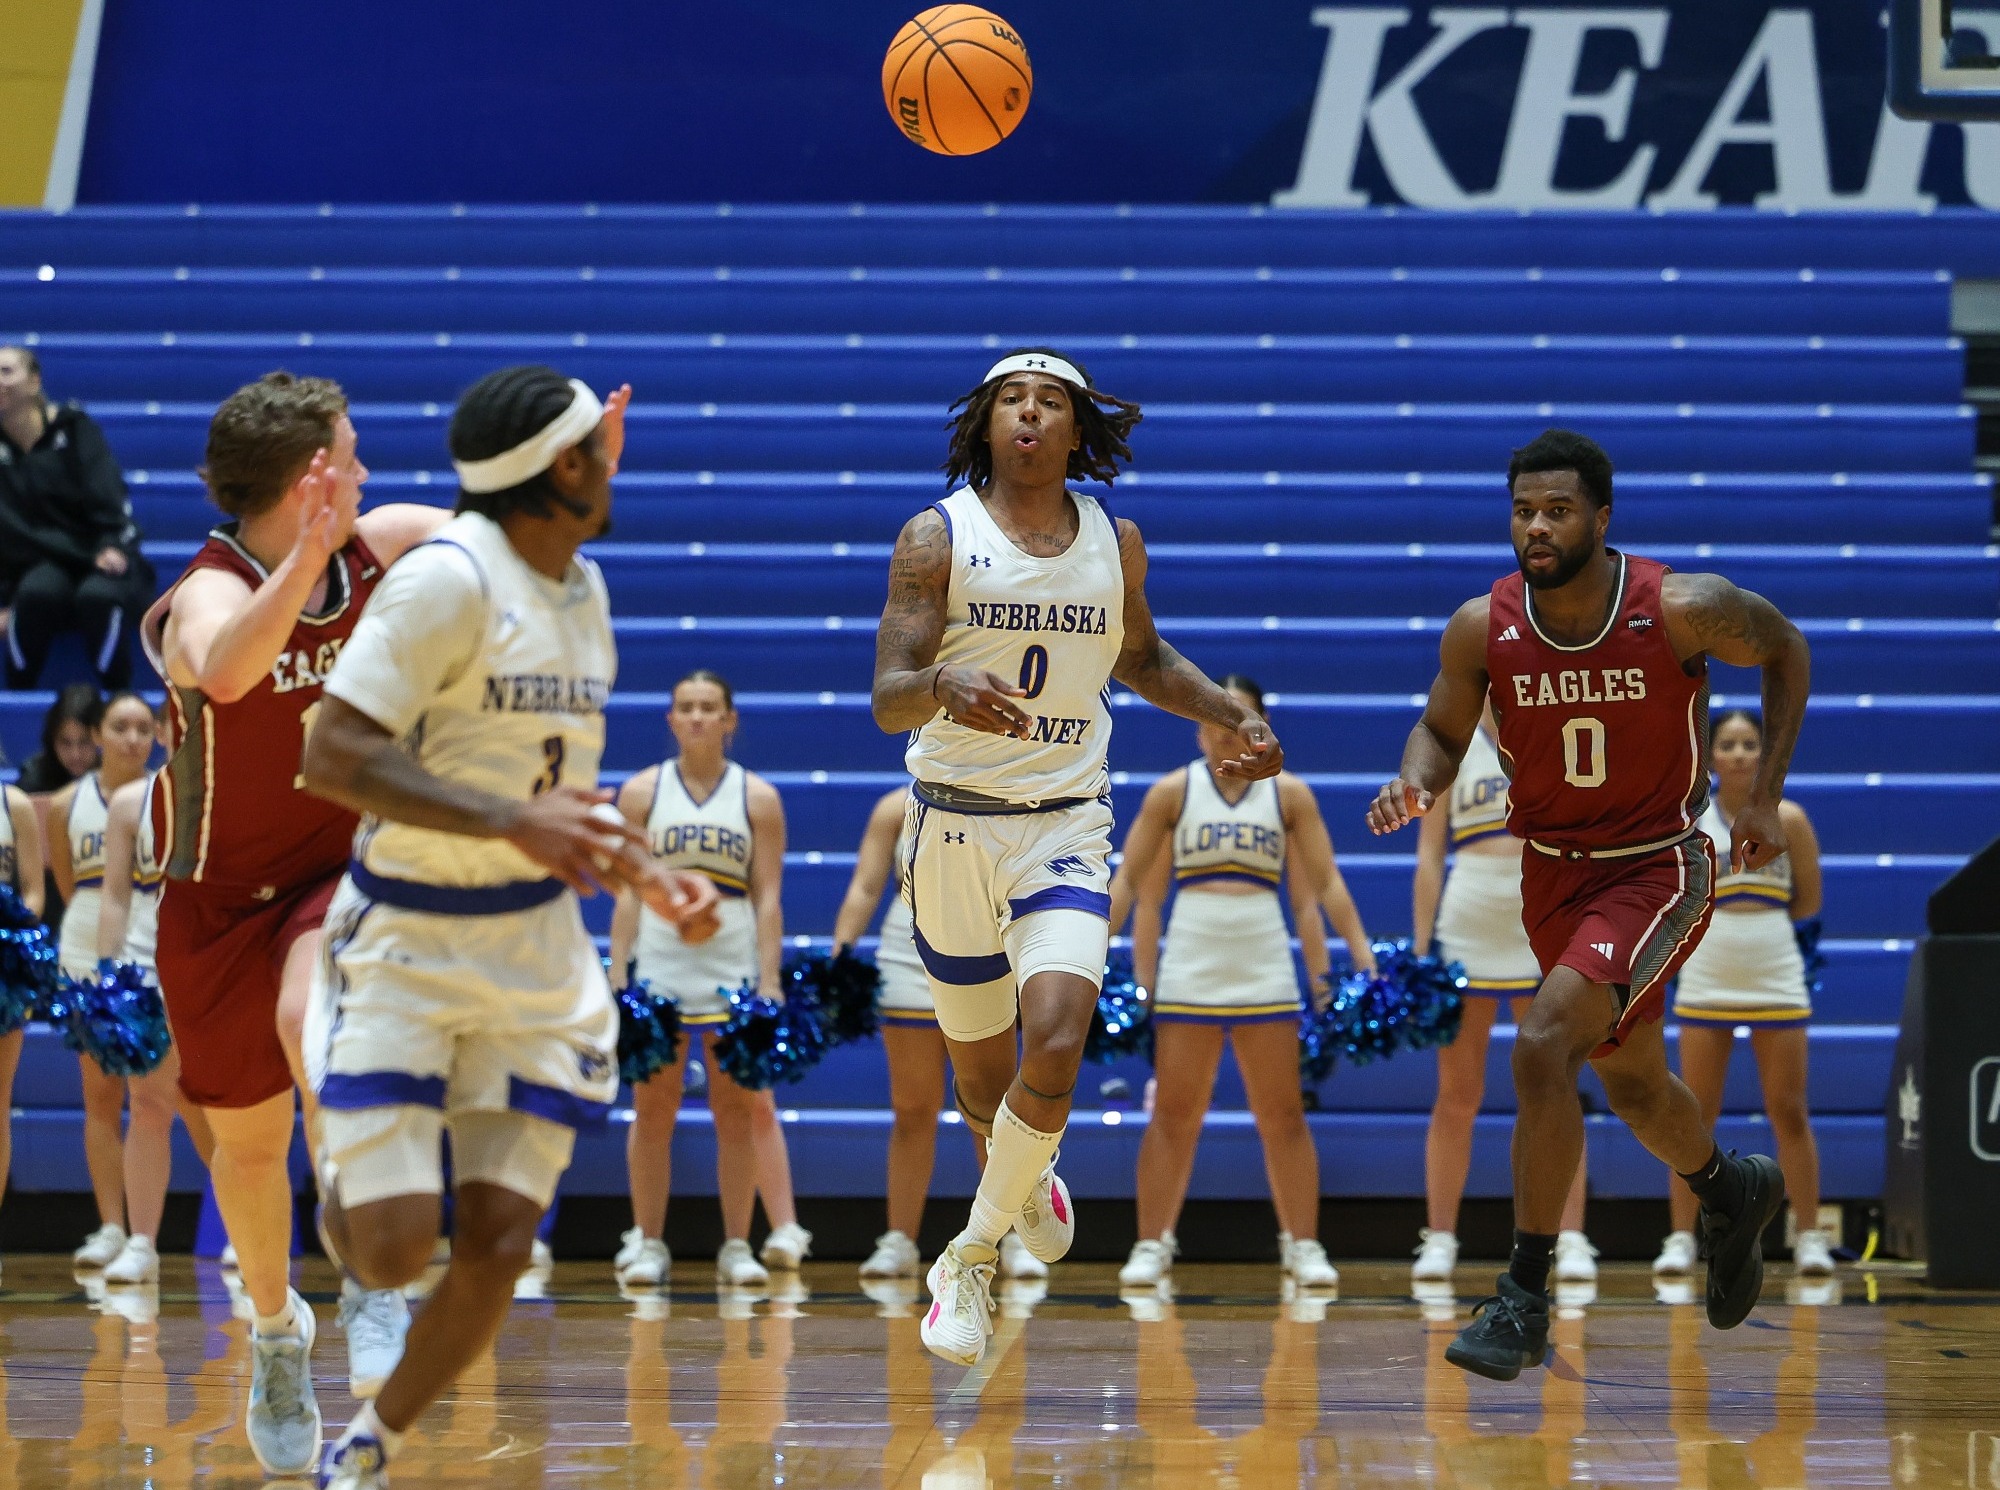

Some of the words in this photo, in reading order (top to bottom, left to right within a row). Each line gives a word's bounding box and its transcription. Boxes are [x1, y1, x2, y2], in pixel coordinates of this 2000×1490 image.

[967, 602, 1107, 635] NEBRASKA
[1628, 619, 1653, 628] RMAC
[272, 638, 343, 694] EAG
[1018, 644, 1049, 700] 0
[1512, 667, 1647, 707] EAGLES
[532, 734, 564, 795] 3
[1562, 717, 1607, 788] 0
[1458, 775, 1511, 813] LOP
[652, 823, 746, 863] LOPERS
[1180, 822, 1280, 860] LOPERS
